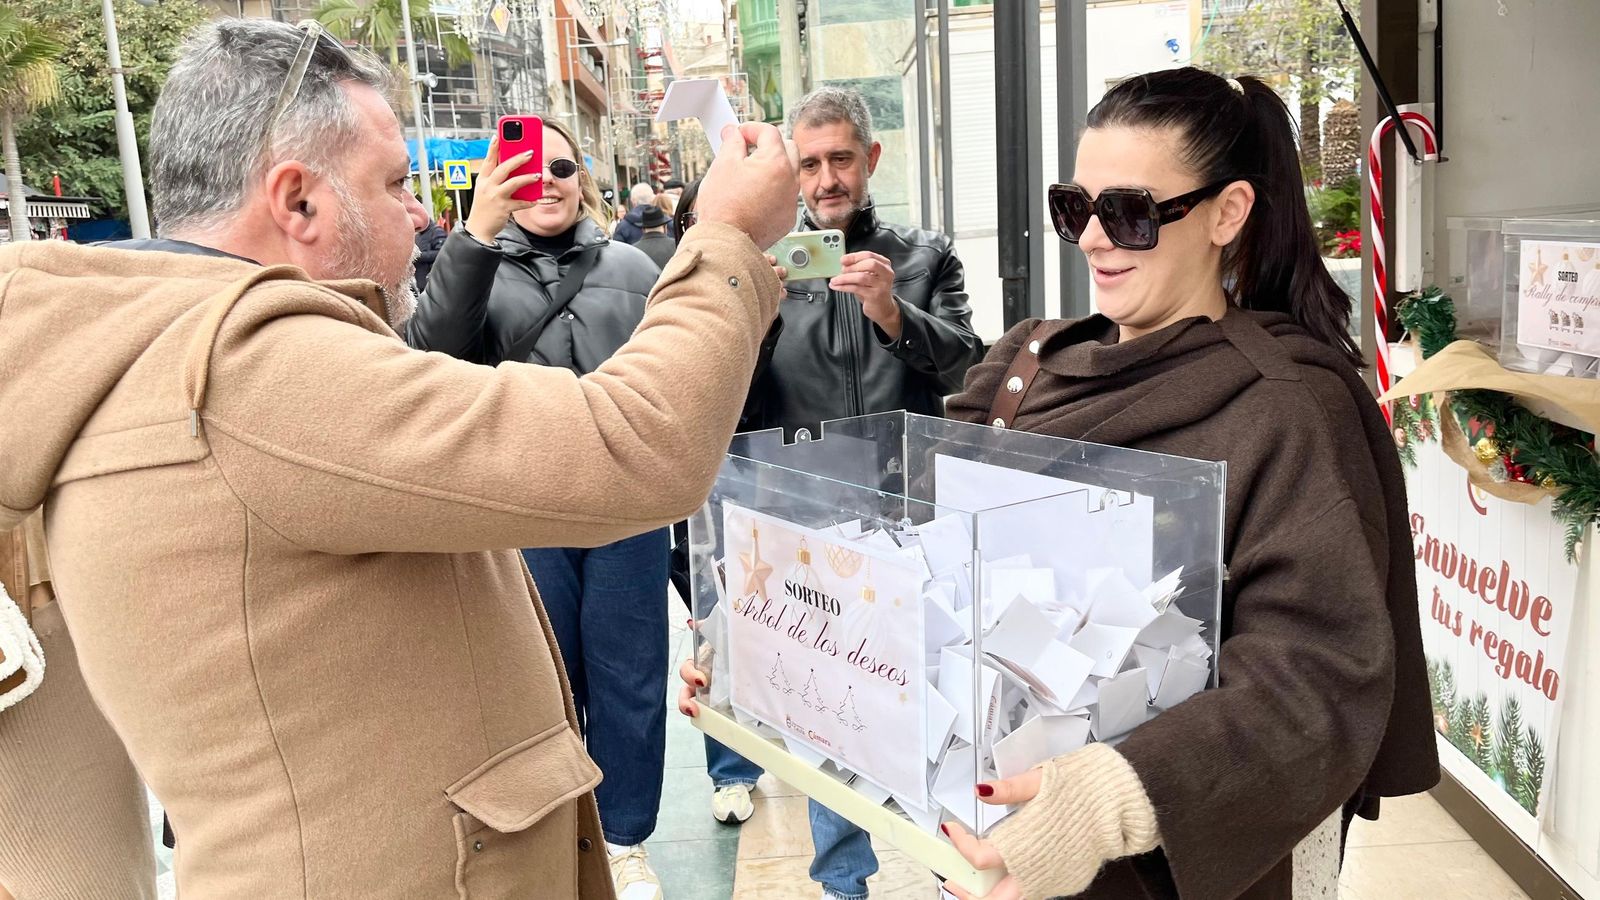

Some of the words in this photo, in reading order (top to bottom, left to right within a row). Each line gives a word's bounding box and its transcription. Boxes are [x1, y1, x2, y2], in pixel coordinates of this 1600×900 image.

[1524, 284, 1553, 307] Rally
[1555, 284, 1567, 301] de
[1557, 271, 1579, 283] SORTEO
[784, 579, 841, 617] SORTEO
[1410, 513, 1553, 637] Envuelve
[734, 590, 783, 632] Árbol
[786, 612, 809, 645] de
[813, 621, 840, 657] los
[847, 638, 909, 687] deseos
[1430, 584, 1463, 637] tus
[1469, 616, 1560, 701] regalo
